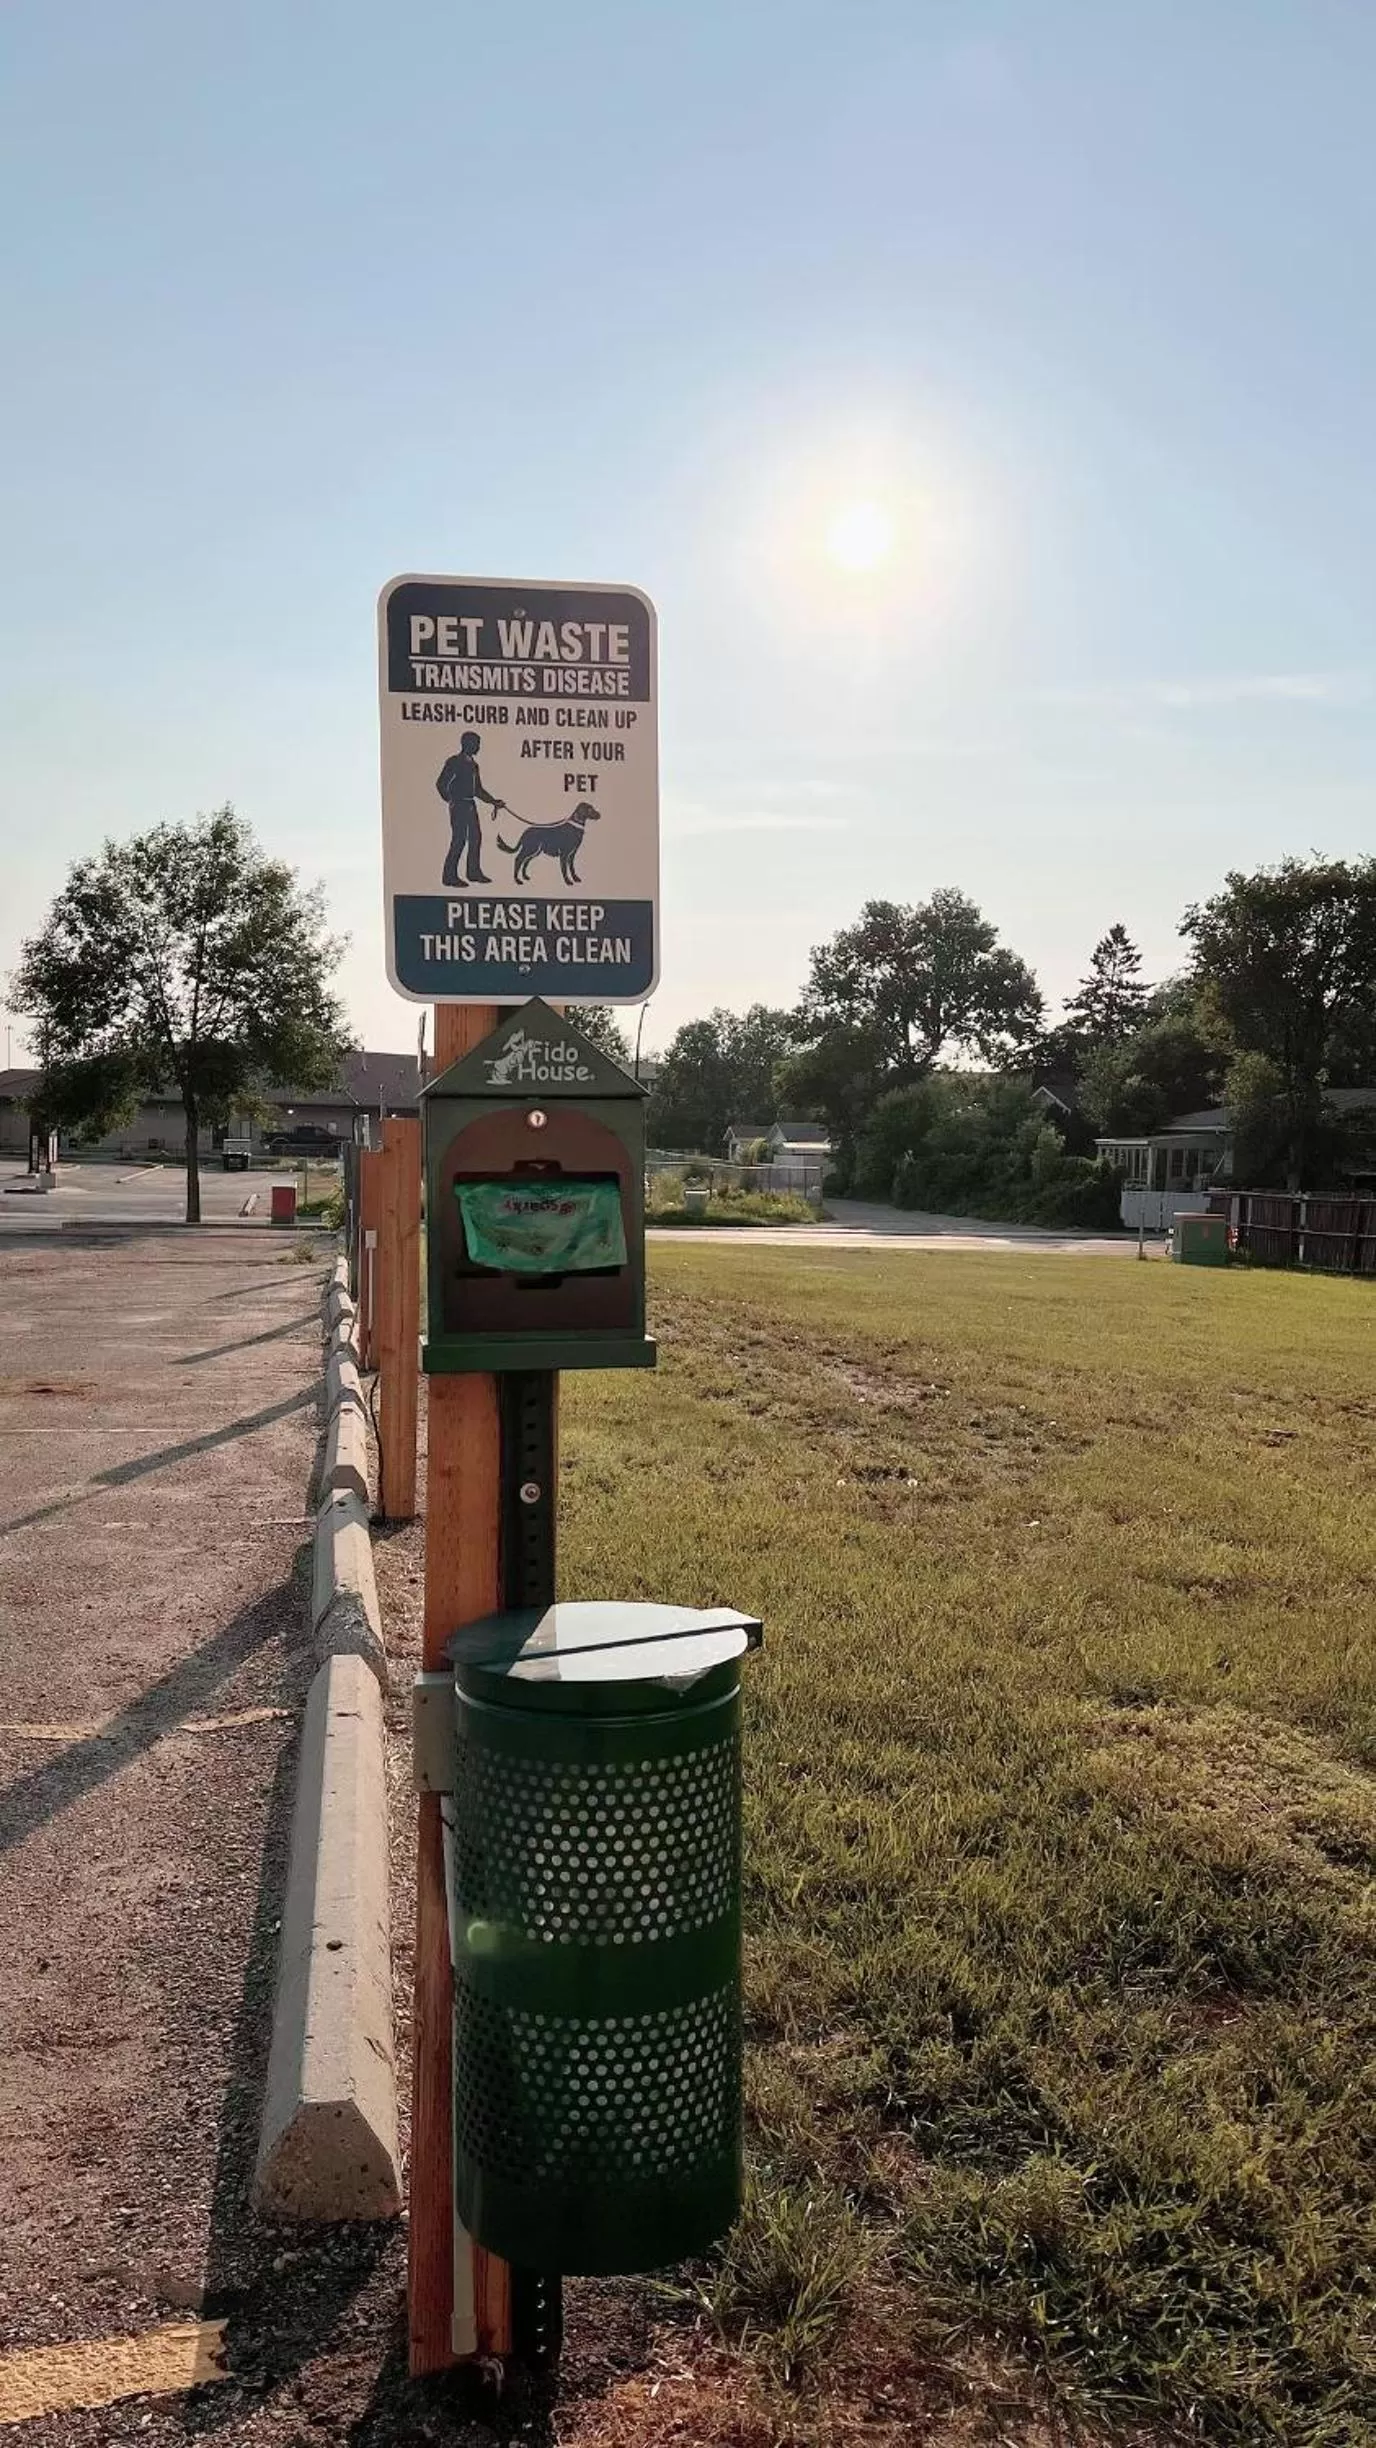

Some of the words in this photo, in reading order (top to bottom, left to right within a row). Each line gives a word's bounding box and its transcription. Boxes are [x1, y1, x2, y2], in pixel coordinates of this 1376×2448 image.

[410, 615, 484, 657] PET
[498, 619, 630, 663] WASTE
[411, 663, 536, 692] TRANSMITS
[543, 668, 630, 695] DISEASE
[401, 702, 509, 725] LEASH-CURB
[515, 706, 549, 726] AND
[556, 707, 609, 728] CLEAN
[615, 710, 638, 729] UP
[520, 740, 573, 760] AFTER
[580, 742, 625, 761] YOUR
[564, 773, 599, 793] PET
[447, 902, 538, 930] PLEASE
[546, 904, 605, 931] KEEP
[420, 934, 476, 961] THIS
[484, 935, 548, 963] AREA
[556, 936, 632, 964] CLEAN
[528, 1040, 579, 1062] Fido
